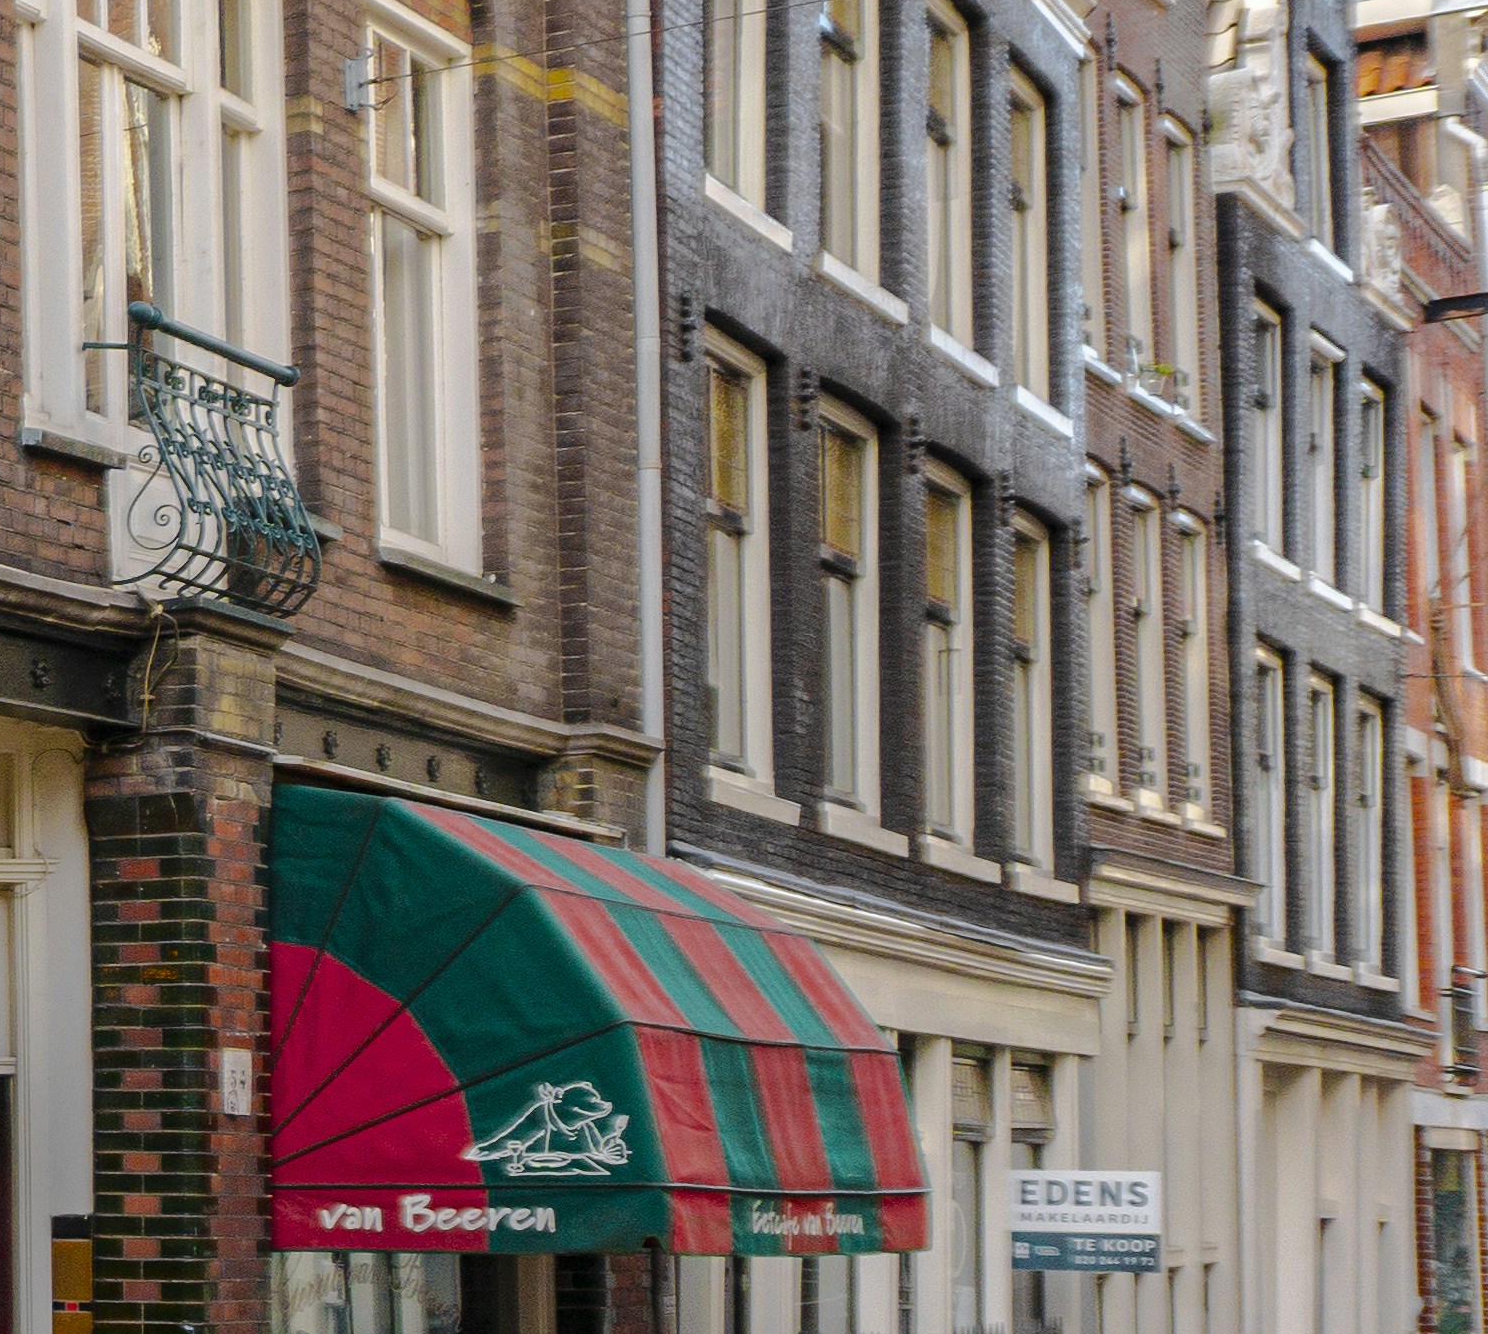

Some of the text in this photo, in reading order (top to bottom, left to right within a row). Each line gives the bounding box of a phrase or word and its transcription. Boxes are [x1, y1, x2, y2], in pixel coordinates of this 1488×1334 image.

[1020, 1179, 1150, 1208] EDENS
[320, 1193, 557, 1233] van Beeren
[1019, 1212, 1150, 1225] MAKELAARDIJ
[1073, 1238, 1157, 1253] TE KOOP
